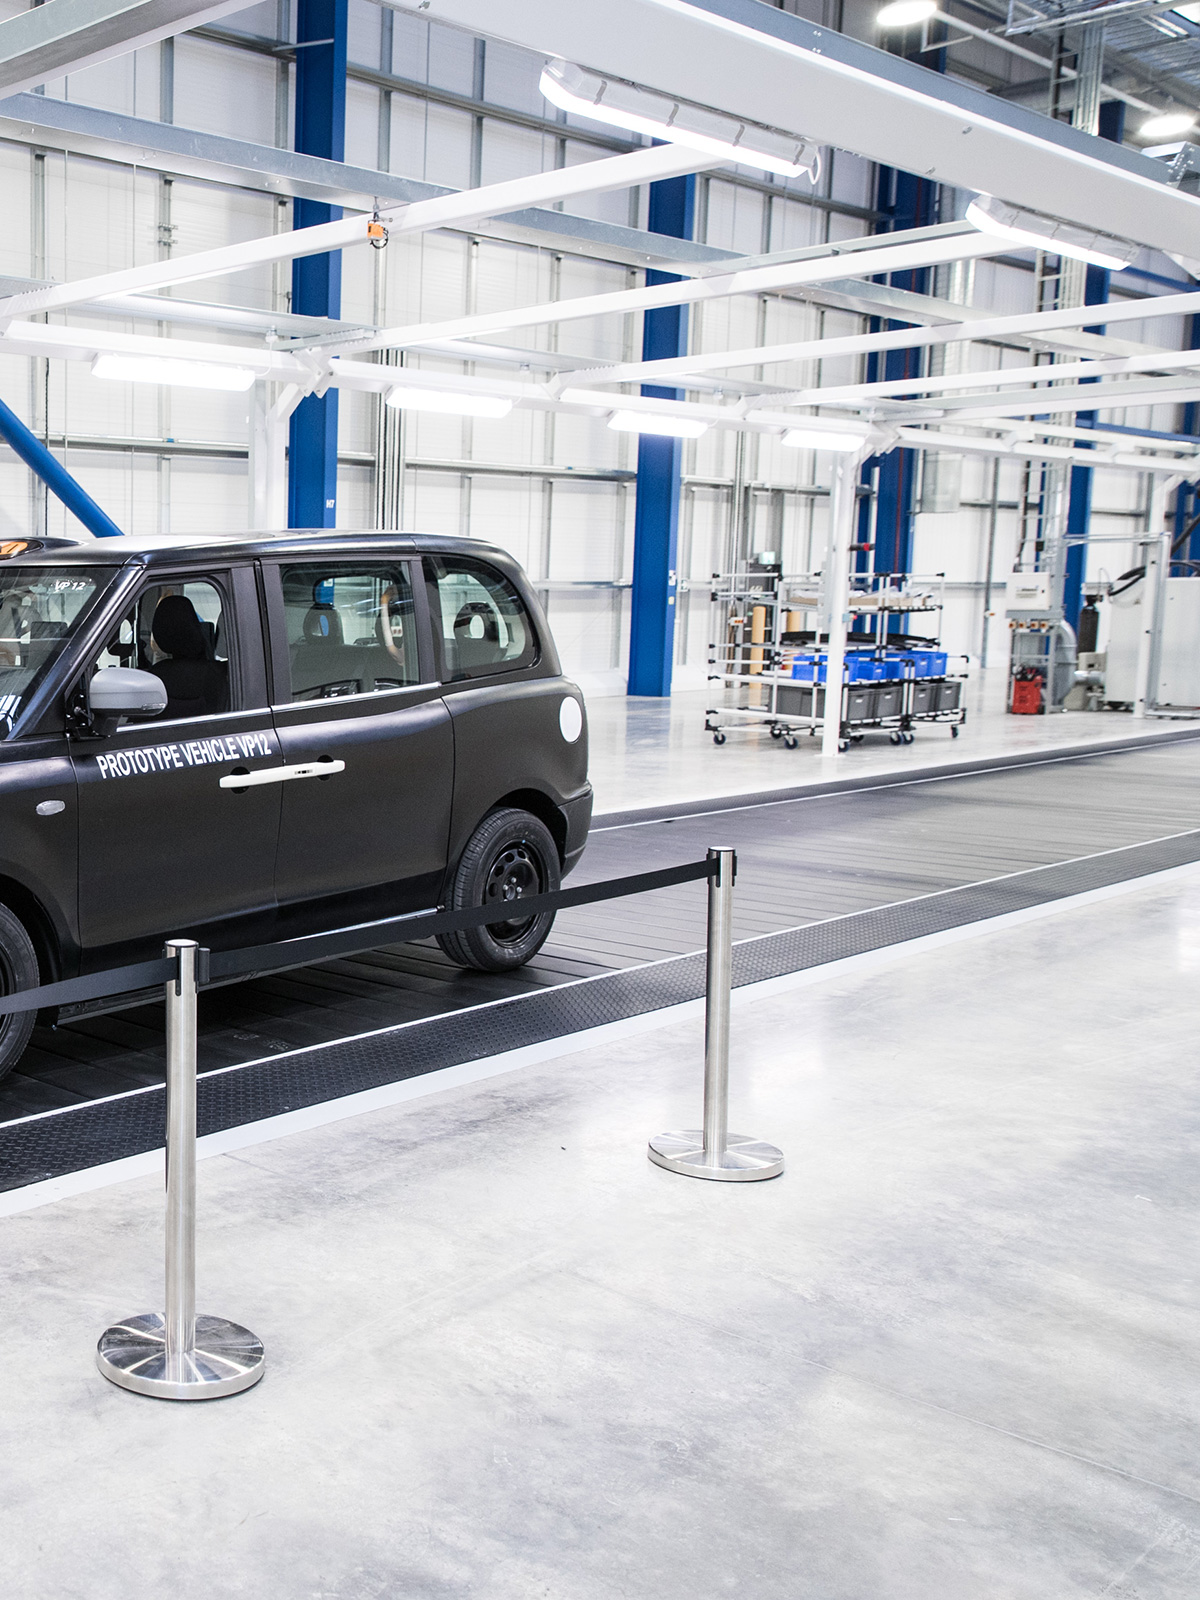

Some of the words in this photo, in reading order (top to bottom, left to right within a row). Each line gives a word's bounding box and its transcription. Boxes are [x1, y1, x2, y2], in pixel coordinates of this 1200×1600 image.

[55, 580, 70, 591] VP
[71, 581, 86, 591] 12
[96, 744, 183, 779] PROTOTYPE
[179, 737, 240, 766] VEHICLE
[236, 733, 272, 758] VP12
